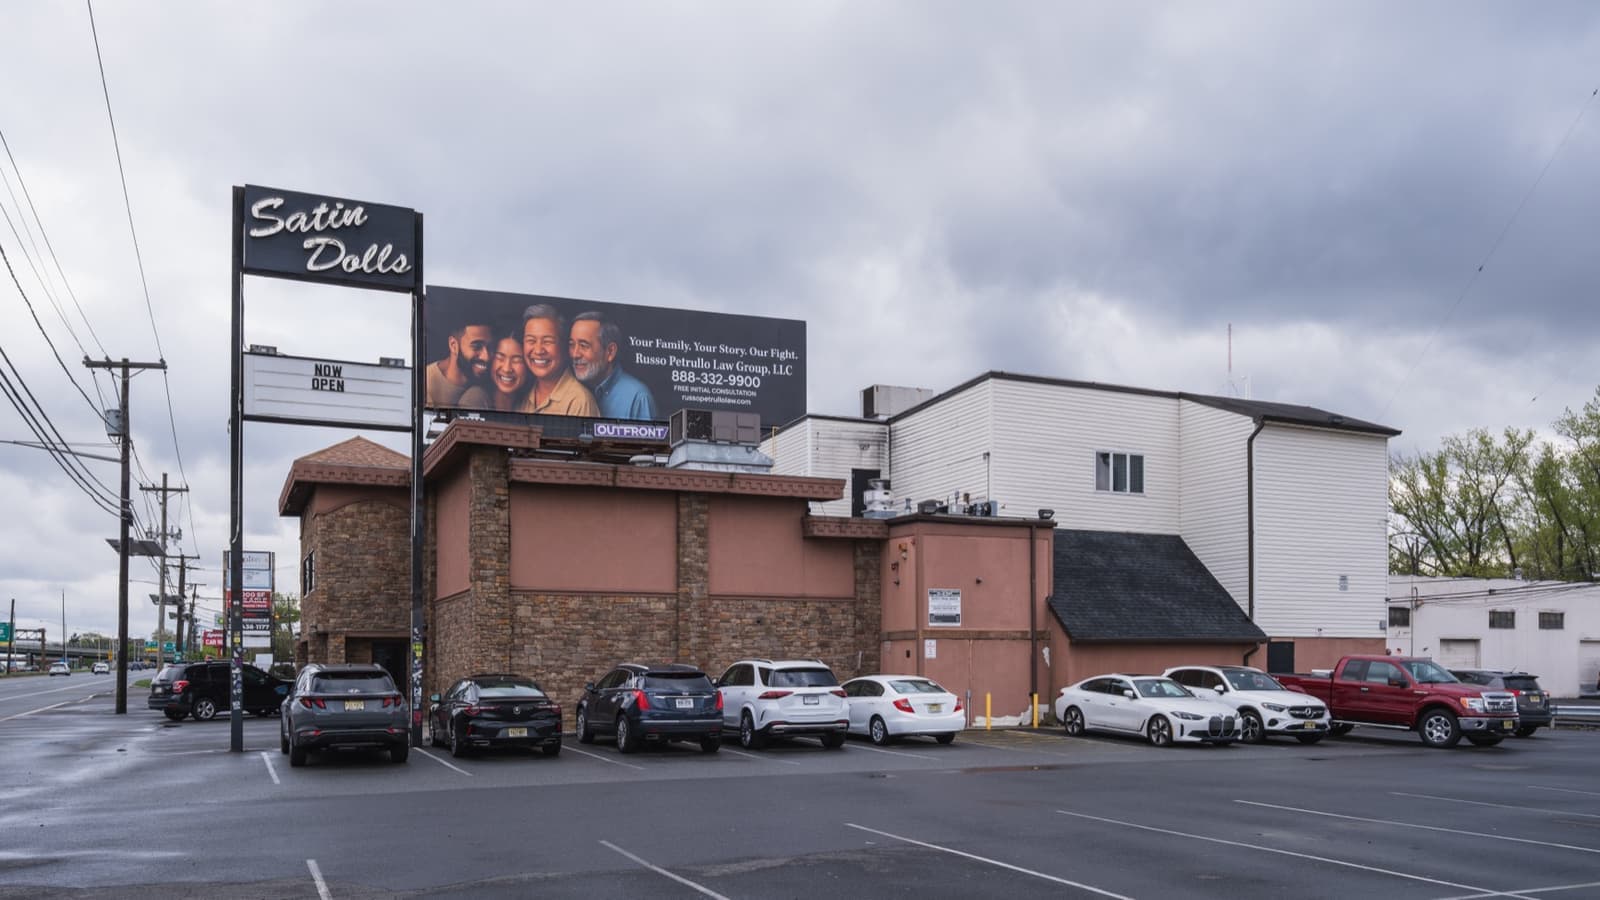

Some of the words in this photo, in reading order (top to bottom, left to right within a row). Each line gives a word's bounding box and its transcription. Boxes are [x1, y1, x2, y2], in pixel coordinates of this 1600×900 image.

[250, 198, 368, 237] Satin
[303, 237, 412, 273] Dolls
[628, 336, 653, 348] Your
[655, 338, 692, 351] Family.
[694, 341, 717, 353] Your
[719, 344, 747, 357] Story.
[749, 347, 768, 357] Our
[770, 348, 798, 361] Fight.
[313, 363, 343, 377] NOW
[635, 353, 667, 366] Russo
[669, 355, 711, 370] Petrullo
[713, 360, 734, 371] Law
[736, 361, 771, 375] Group,
[773, 364, 793, 376] LLC
[311, 377, 345, 393] OPEN
[671, 370, 761, 388] 888-332-9900
[673, 384, 690, 392] FREE
[690, 386, 711, 394] INITIAL
[711, 387, 757, 397] CONSULTATION
[681, 395, 752, 405] russopetrullolaw.com
[597, 424, 665, 438] OUTFRONT
